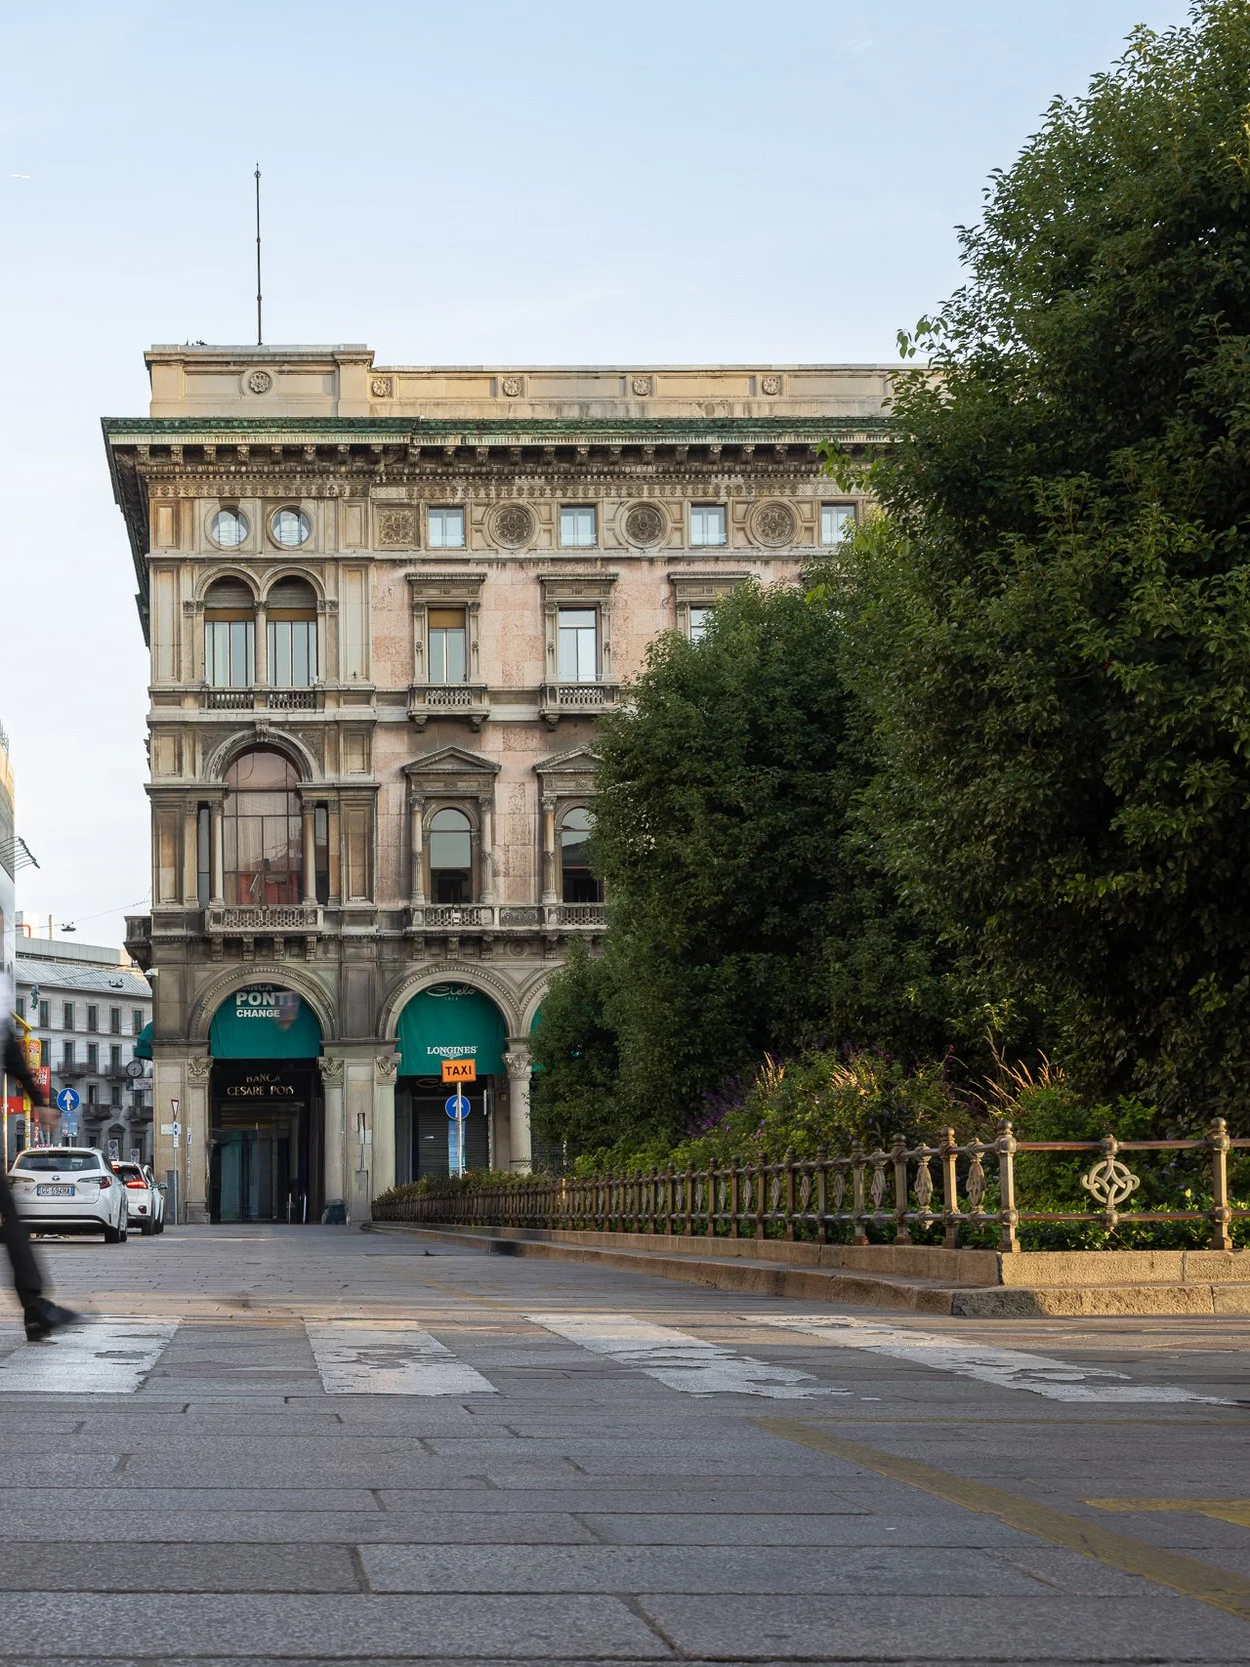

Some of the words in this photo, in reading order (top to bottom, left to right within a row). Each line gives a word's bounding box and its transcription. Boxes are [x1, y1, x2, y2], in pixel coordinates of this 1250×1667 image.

[236, 1009, 281, 1018] CHANGE
[426, 1046, 477, 1055] LONGINES
[445, 1065, 472, 1075] TAXI
[226, 1086, 265, 1096] CESARE
